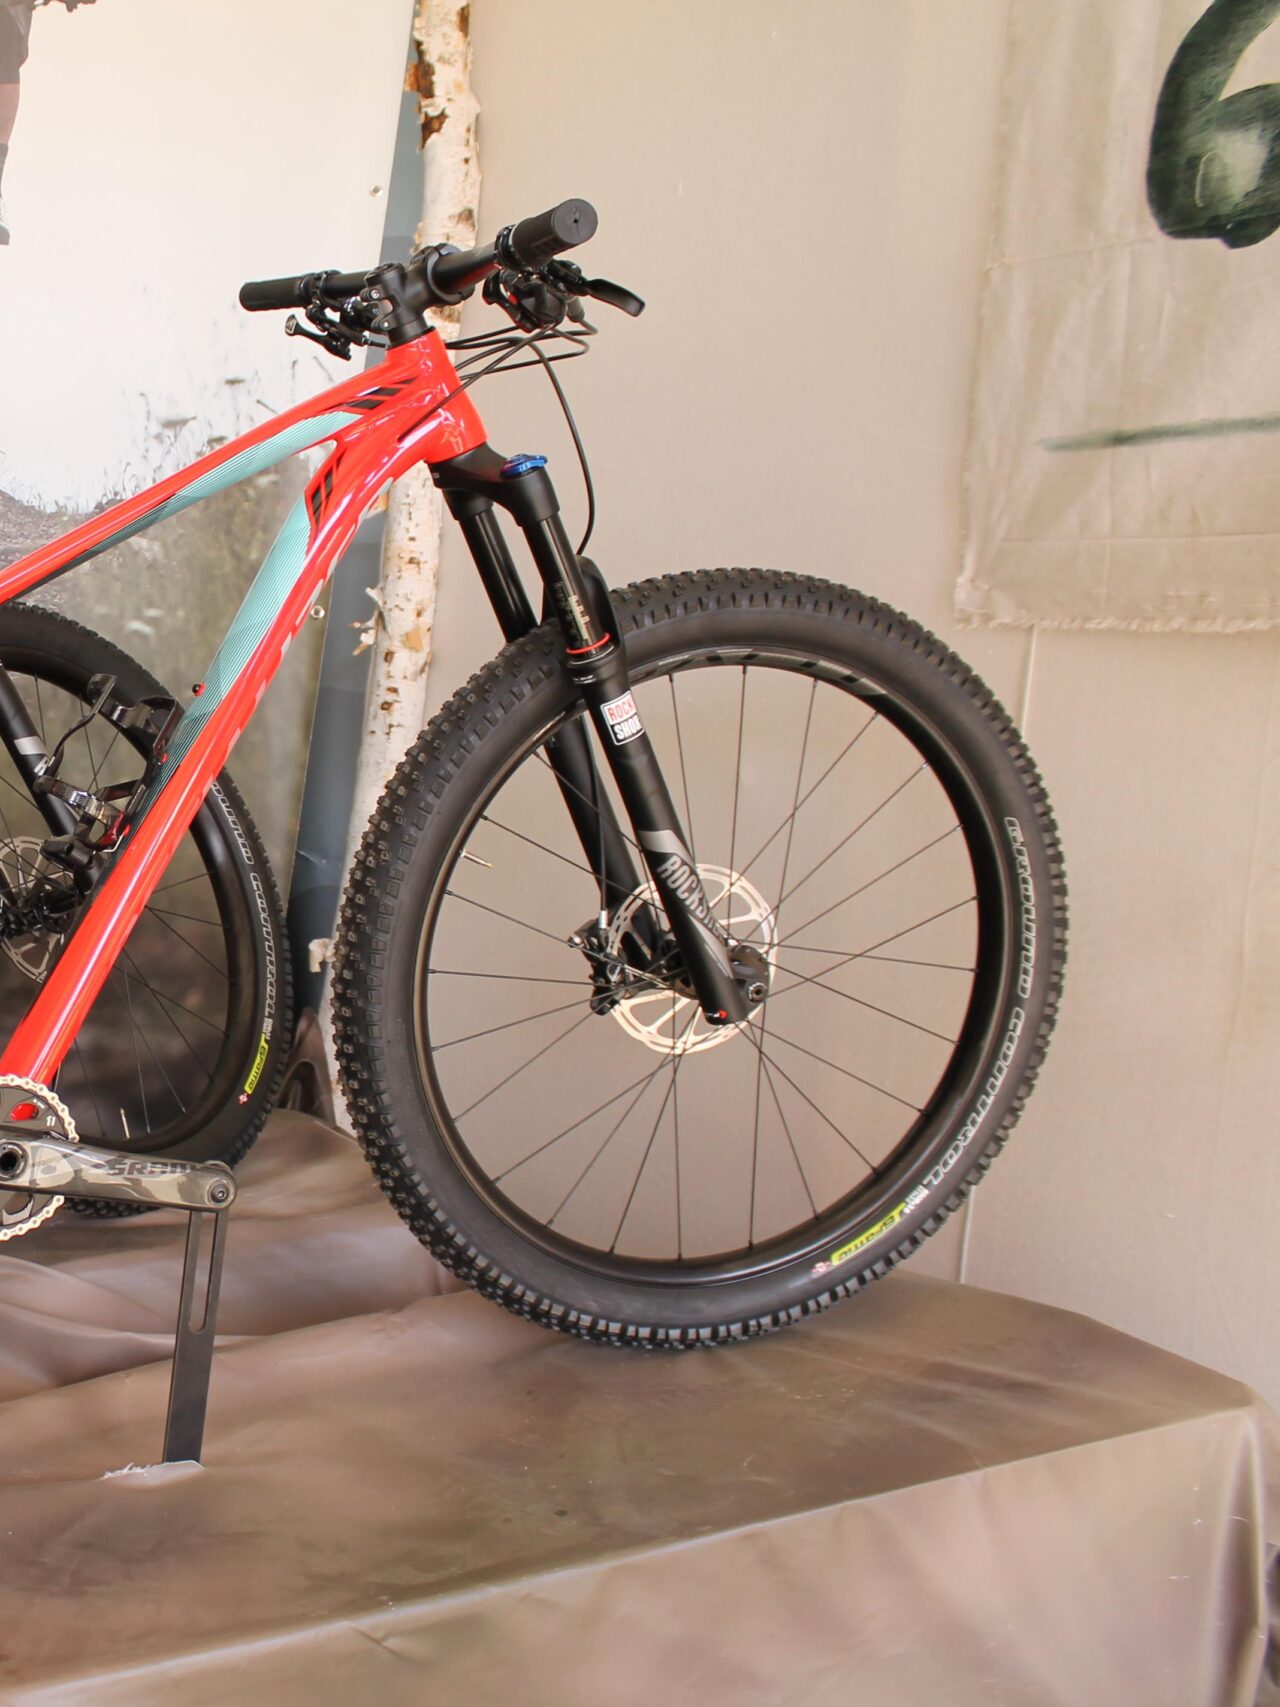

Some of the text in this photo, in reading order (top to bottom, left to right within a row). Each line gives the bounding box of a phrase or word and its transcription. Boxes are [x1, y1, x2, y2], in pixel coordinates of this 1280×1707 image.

[210, 781, 277, 1017] OUND CONTROL
[923, 817, 1037, 1186] GROUND CONTROL
